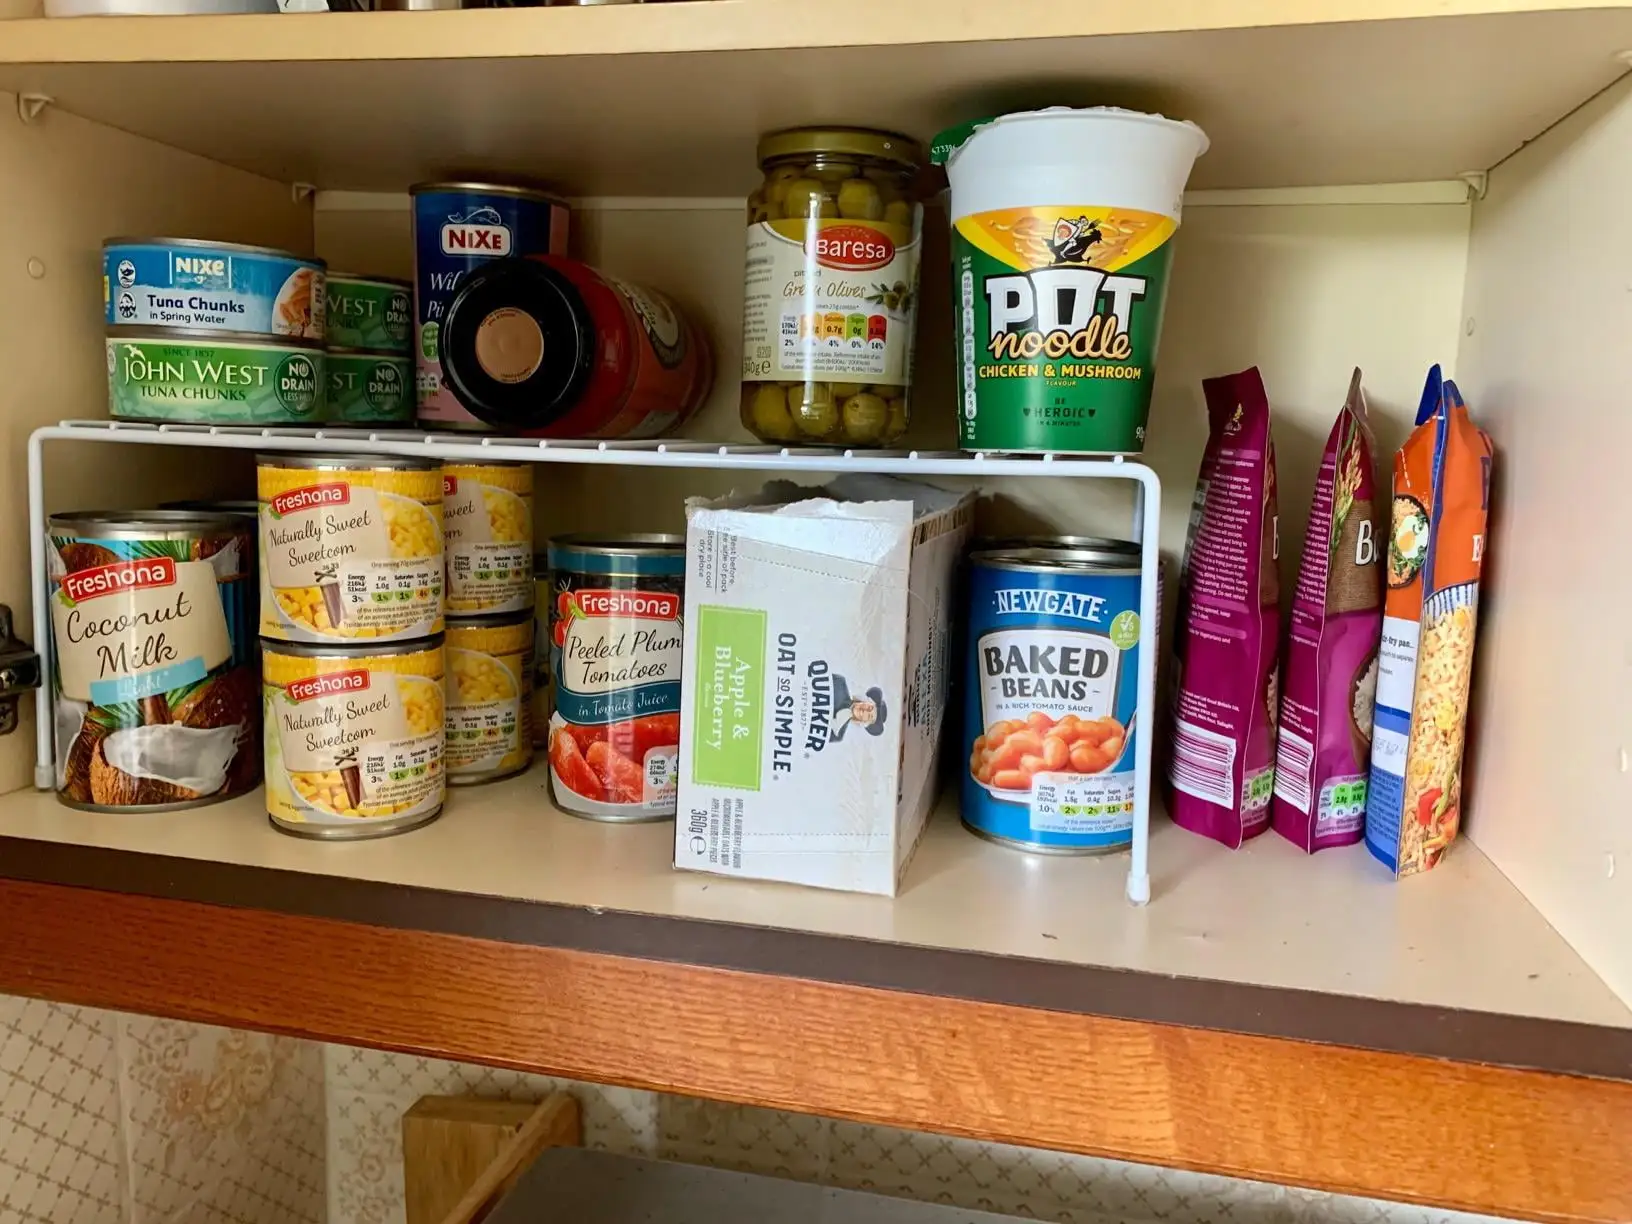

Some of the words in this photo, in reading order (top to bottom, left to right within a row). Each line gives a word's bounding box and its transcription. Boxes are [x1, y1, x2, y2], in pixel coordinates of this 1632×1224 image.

[815, 238, 886, 259] Baresa
[430, 270, 464, 292] Wil
[826, 281, 867, 300] Olives
[147, 294, 184, 309] Tuna
[188, 296, 245, 314] Chunks
[985, 268, 1147, 336] POT
[149, 311, 158, 320] in
[160, 311, 192, 324] Spring
[194, 314, 226, 324] Water
[988, 314, 1132, 360] noodle
[123, 356, 185, 385] JOHN
[192, 359, 269, 386] WEST
[288, 362, 310, 378] NO
[978, 364, 1039, 378] CHICKEN
[1043, 364, 1056, 377] &
[1061, 364, 1142, 380] MUSHROOM
[141, 384, 178, 399] TUNA
[182, 386, 247, 401] CHUNKS
[281, 377, 315, 392] DRAIN
[1034, 407, 1086, 418] HEROIC
[275, 488, 343, 513] Freshona
[269, 519, 323, 548] Naturally
[326, 509, 372, 535] Sweet
[697, 538, 706, 554] dry
[698, 554, 706, 578] place
[67, 564, 166, 599] Freshona
[705, 571, 713, 589] cool
[719, 573, 728, 593] pack
[581, 594, 672, 616] Freshona
[994, 588, 1107, 623] NEWGATE
[66, 591, 193, 644] Coconut
[96, 632, 178, 679] Milk
[568, 632, 627, 660] Peeled
[630, 628, 682, 656] Plum
[777, 632, 797, 675] OAT
[582, 661, 668, 685] Tomatoes
[983, 644, 1109, 679] BAKED
[291, 674, 363, 700] Freshona
[728, 656, 752, 719] Apple
[777, 677, 791, 692] SO
[1001, 677, 1087, 701] BEANS
[578, 704, 592, 718] in
[592, 698, 634, 715] Tomato
[637, 691, 669, 710] Juice
[705, 644, 732, 751] Blueberry
[804, 659, 830, 752] QUAKER
[1012, 702, 1030, 710] RICH
[1031, 702, 1065, 711] TOMATO
[1067, 704, 1093, 713] SAUCE
[283, 705, 343, 733] Naturally
[346, 693, 391, 720] Sweet
[732, 723, 750, 740] &
[773, 693, 794, 773] SIMPLE
[688, 808, 708, 834] 360g
